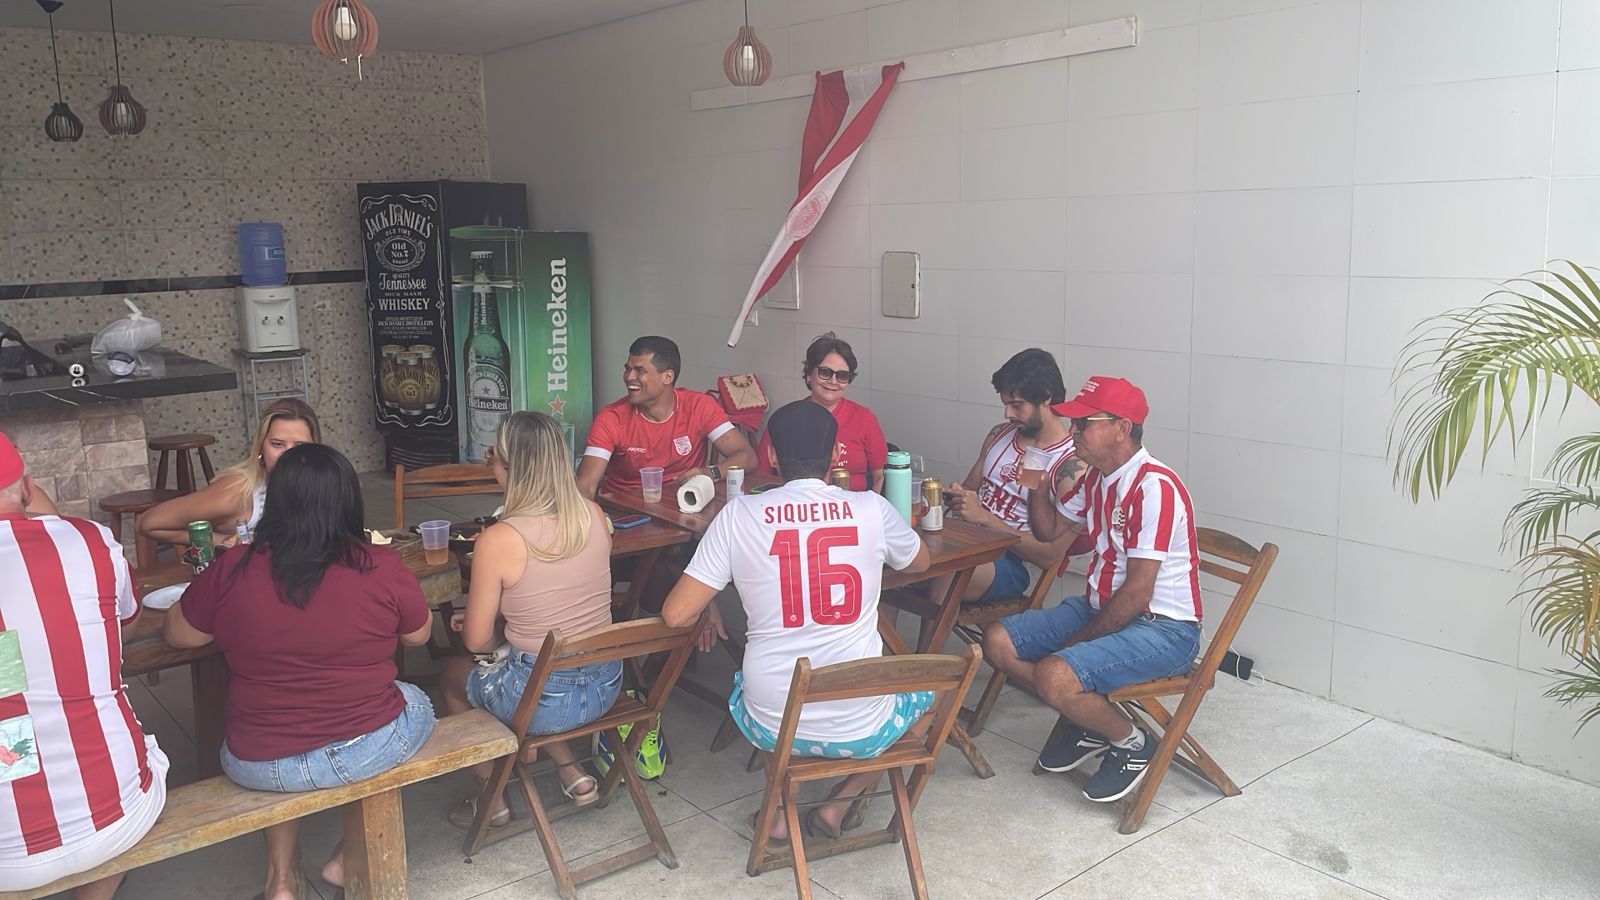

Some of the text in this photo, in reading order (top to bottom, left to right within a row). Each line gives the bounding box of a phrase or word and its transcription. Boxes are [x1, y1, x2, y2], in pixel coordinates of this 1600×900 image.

[365, 203, 434, 240] JACK DANIEL'S
[385, 228, 411, 236] OLD TIME
[391, 242, 407, 250] Old
[378, 272, 428, 290] Tennessee
[378, 298, 430, 311] WHISKEY
[546, 257, 568, 392] Heineken
[468, 398, 508, 411] Heineken
[764, 501, 853, 524] SIQUEIRA
[769, 526, 863, 628] 16
